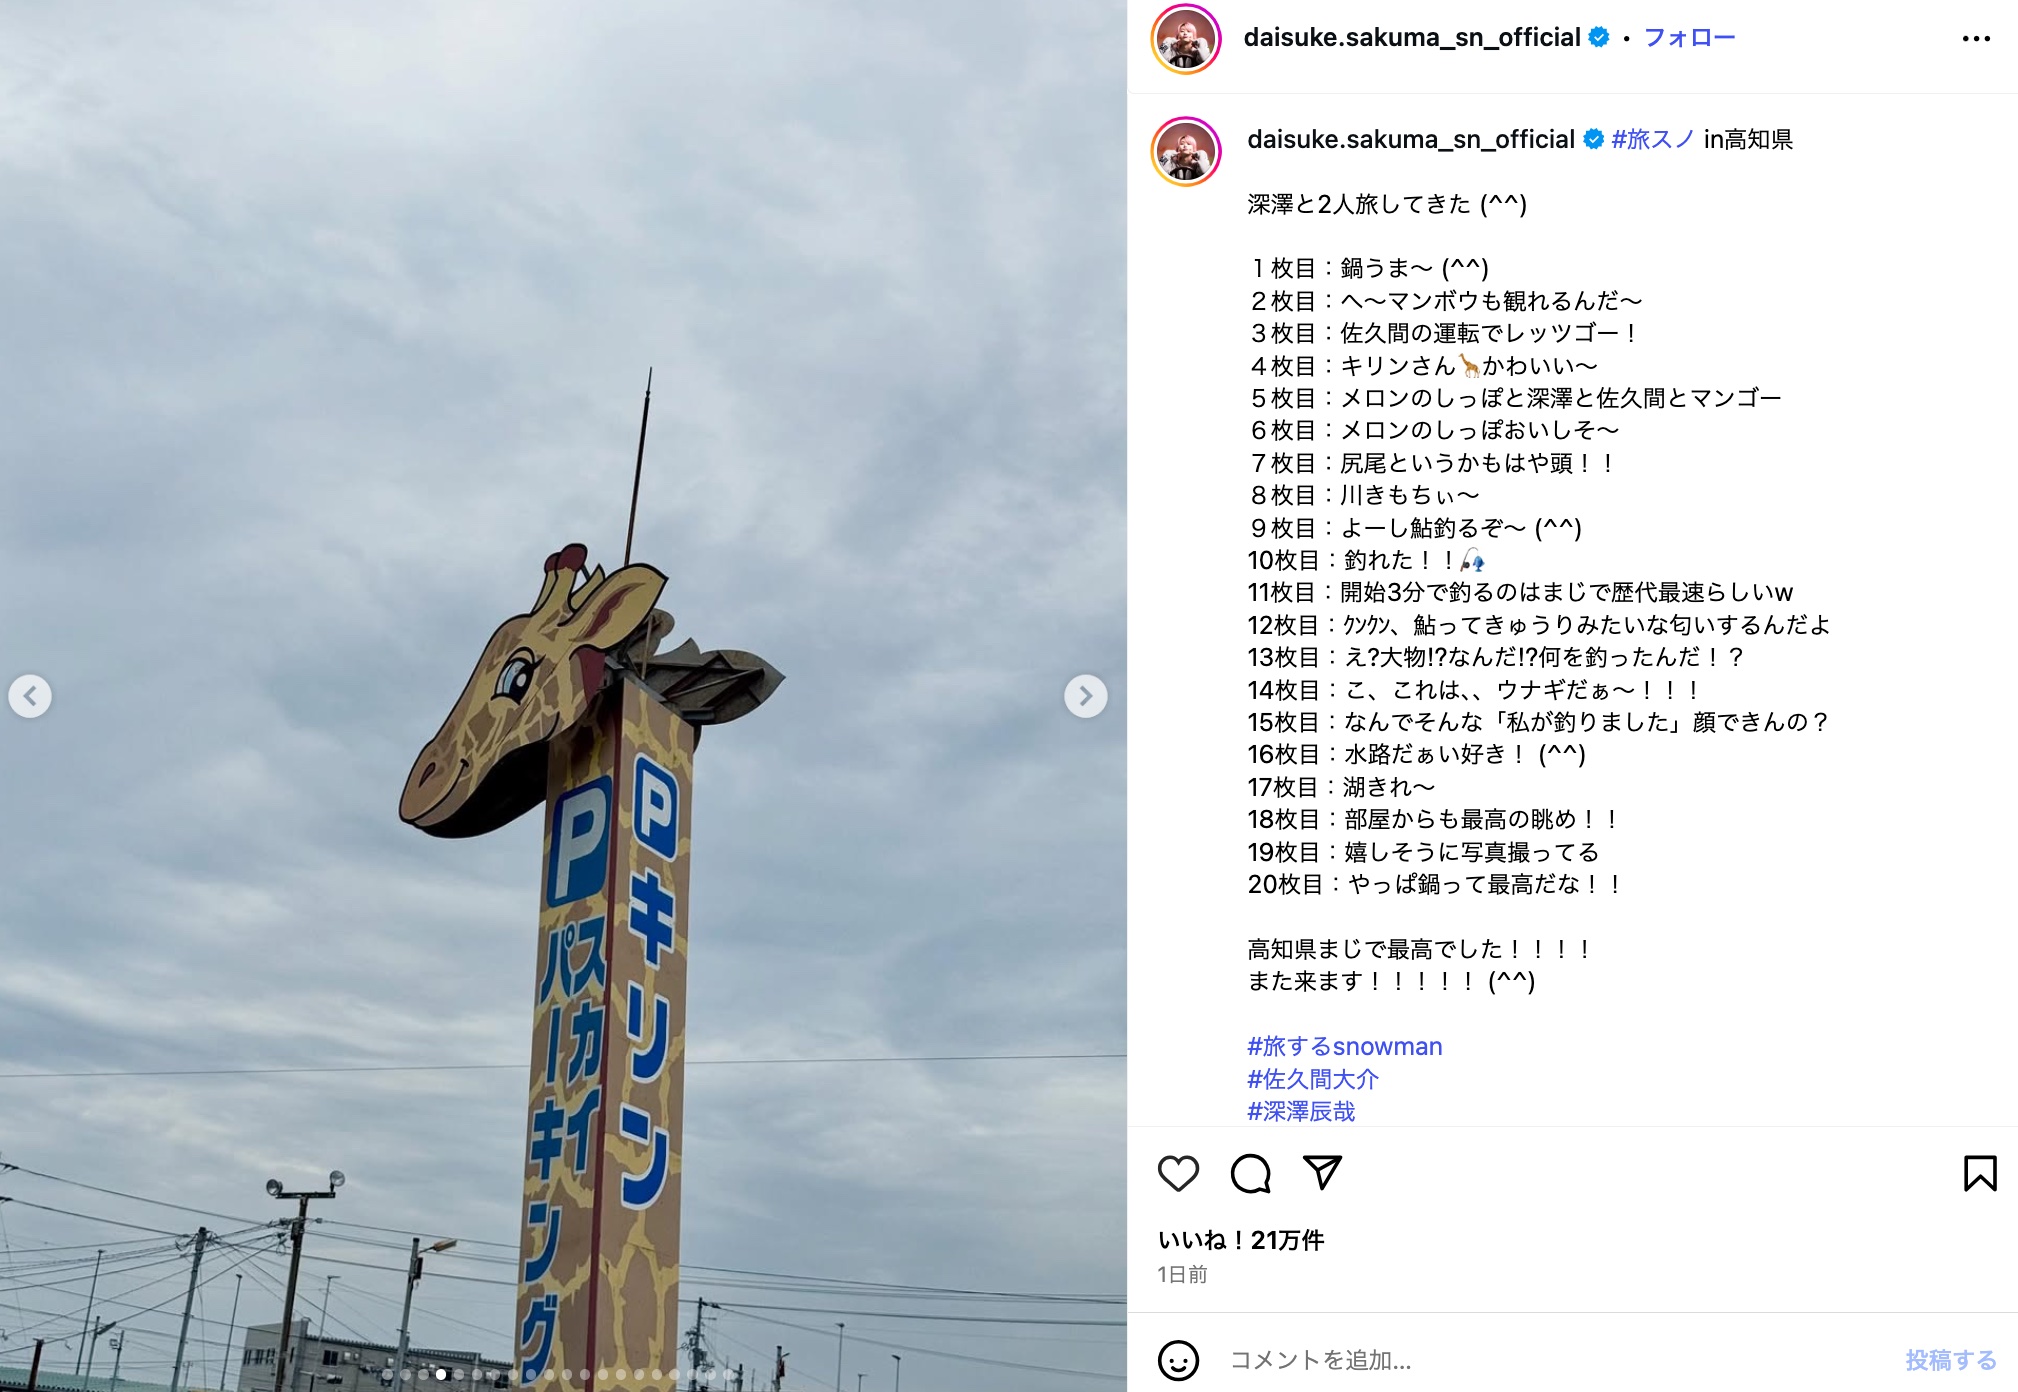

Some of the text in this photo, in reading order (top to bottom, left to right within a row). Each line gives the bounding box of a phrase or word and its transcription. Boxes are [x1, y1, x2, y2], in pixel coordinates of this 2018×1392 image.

[1244, 26, 1580, 50] daisuke.sakuma_sn_official
[1646, 28, 1735, 49] フォロー
[1248, 128, 1793, 152] daisuke.sakuma_sn_official #旅スノ in高知県
[1248, 193, 1470, 215] 深澤と2人旅してきた
[553, 786, 606, 900] P
[566, 914, 606, 1174] スカイ
[620, 867, 676, 1210] キリン
[1247, 1035, 1442, 1057] #旅するsnowman
[1247, 1068, 1379, 1090] #佐久間大介
[1247, 1100, 1355, 1122] #深澤辰哉
[520, 920, 576, 1388] パーキング
[1158, 1228, 1325, 1251] いいね！21万件
[1158, 1265, 1207, 1284] 1日前
[1906, 1349, 1996, 1371] 投稿する
